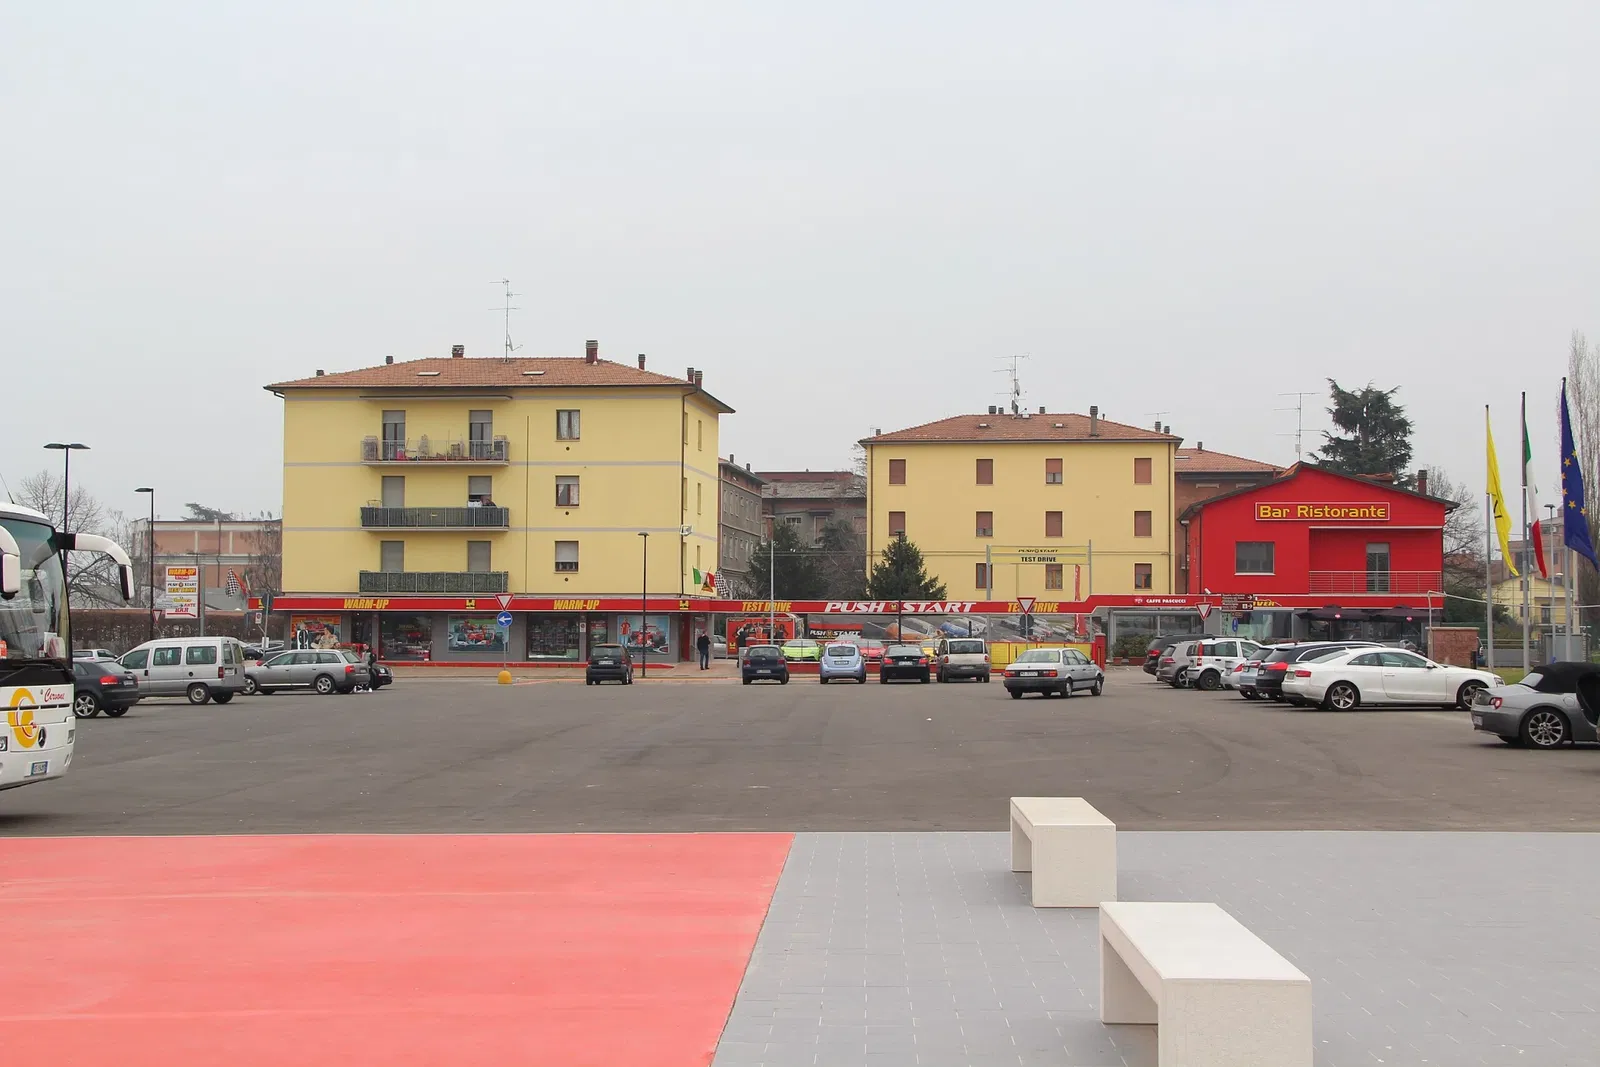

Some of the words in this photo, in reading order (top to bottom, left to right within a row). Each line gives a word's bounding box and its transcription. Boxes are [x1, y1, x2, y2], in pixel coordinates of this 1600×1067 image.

[1259, 505, 1290, 518] Bar
[1297, 505, 1386, 518] Ristorante
[344, 598, 389, 609] WARM-UP
[553, 599, 600, 610] WARM-UP
[742, 601, 764, 612] TEST
[763, 601, 792, 612] DRIVE
[824, 601, 885, 613] PUSH
[901, 601, 977, 613] START
